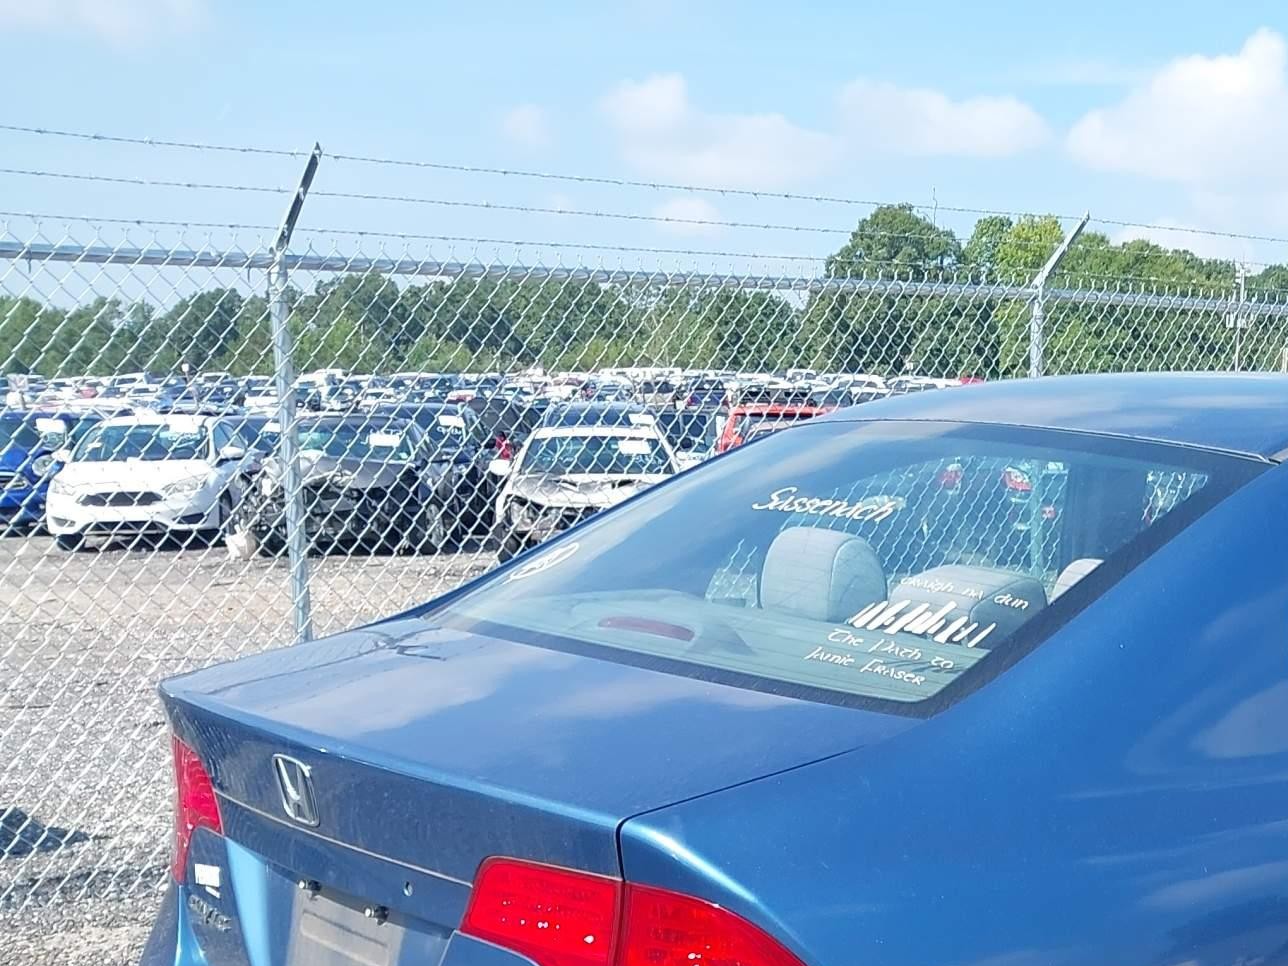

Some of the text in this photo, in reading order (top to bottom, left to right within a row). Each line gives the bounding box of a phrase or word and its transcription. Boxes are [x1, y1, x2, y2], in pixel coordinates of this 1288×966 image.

[752, 486, 897, 522] Sassenach
[994, 592, 1029, 610] dun
[803, 645, 856, 668] Jamie
[827, 627, 954, 670] The Path to
